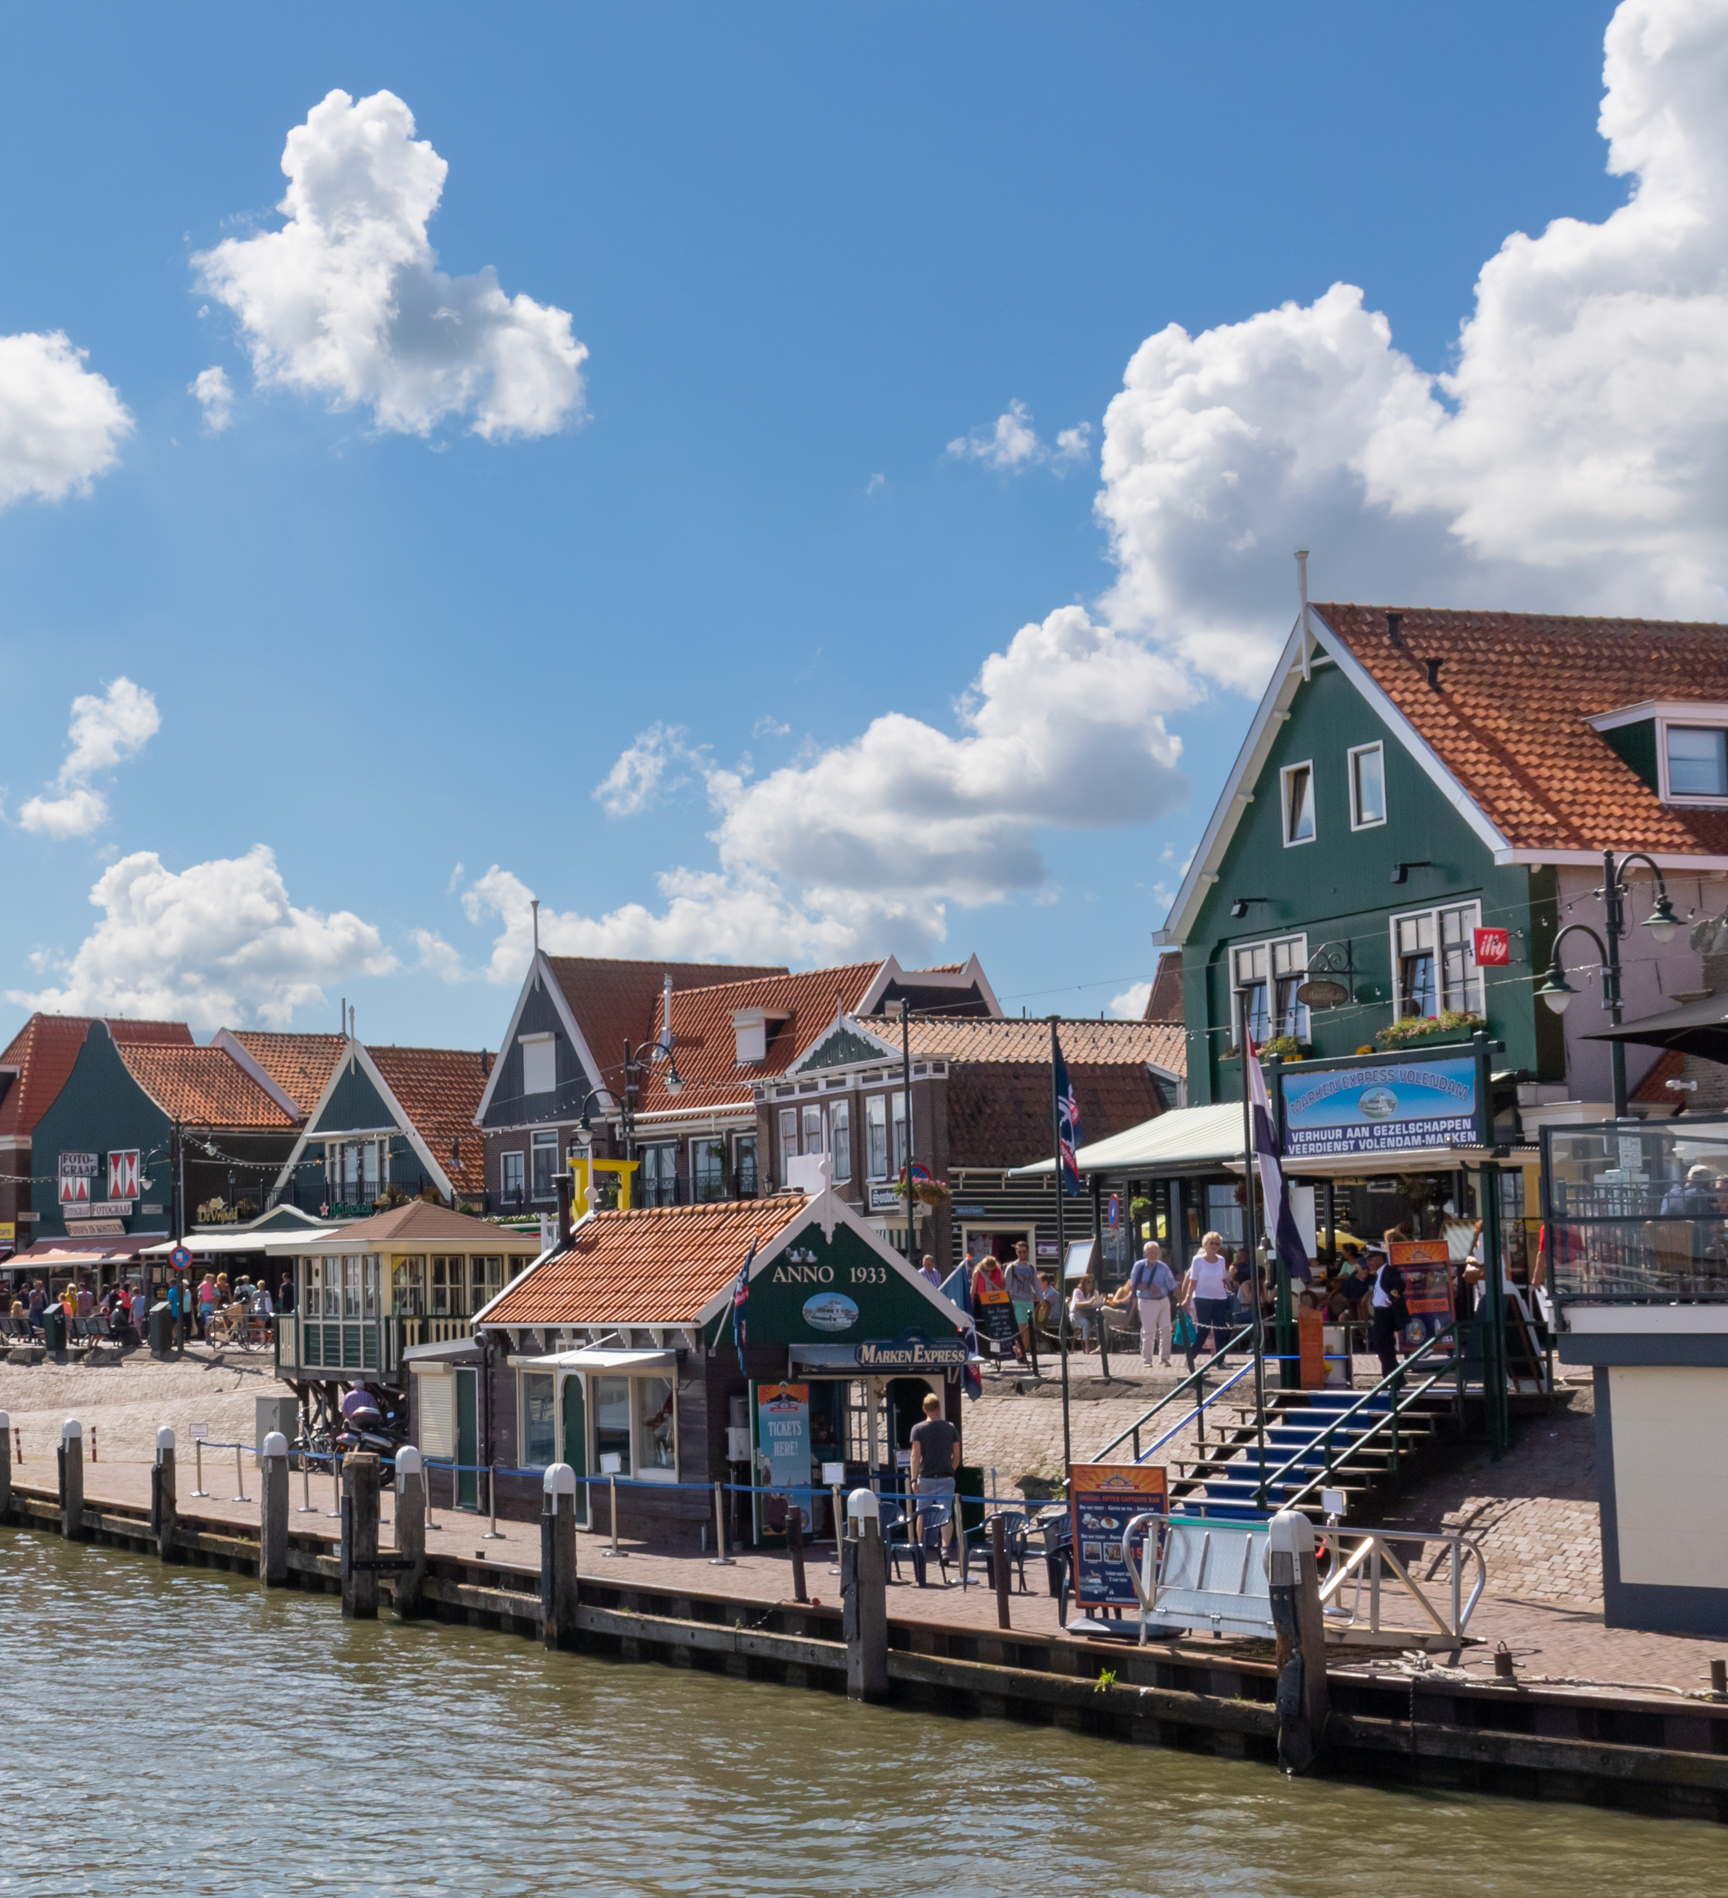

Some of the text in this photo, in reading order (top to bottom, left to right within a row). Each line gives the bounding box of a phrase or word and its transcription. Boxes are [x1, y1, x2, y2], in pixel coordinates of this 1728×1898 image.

[1480, 933, 1507, 961] illy
[1290, 1069, 1469, 1116] MARKEN EXPRESS VOLENDAM
[1291, 1118, 1471, 1143] VERHUUR AAN GEZELSCHAPPEN
[1288, 1140, 1355, 1155] VEERDIENST
[62, 1153, 94, 1164] FOTO-
[62, 1165, 97, 1176] GRAAF
[92, 1203, 132, 1216] FOTOGRAAF
[329, 1201, 372, 1214] Heineken
[772, 1265, 887, 1284] ANNO 1933
[861, 1344, 966, 1364] MARKEN EXPRESS
[767, 1420, 803, 1437] TICKETS
[773, 1441, 799, 1457] HERE!
